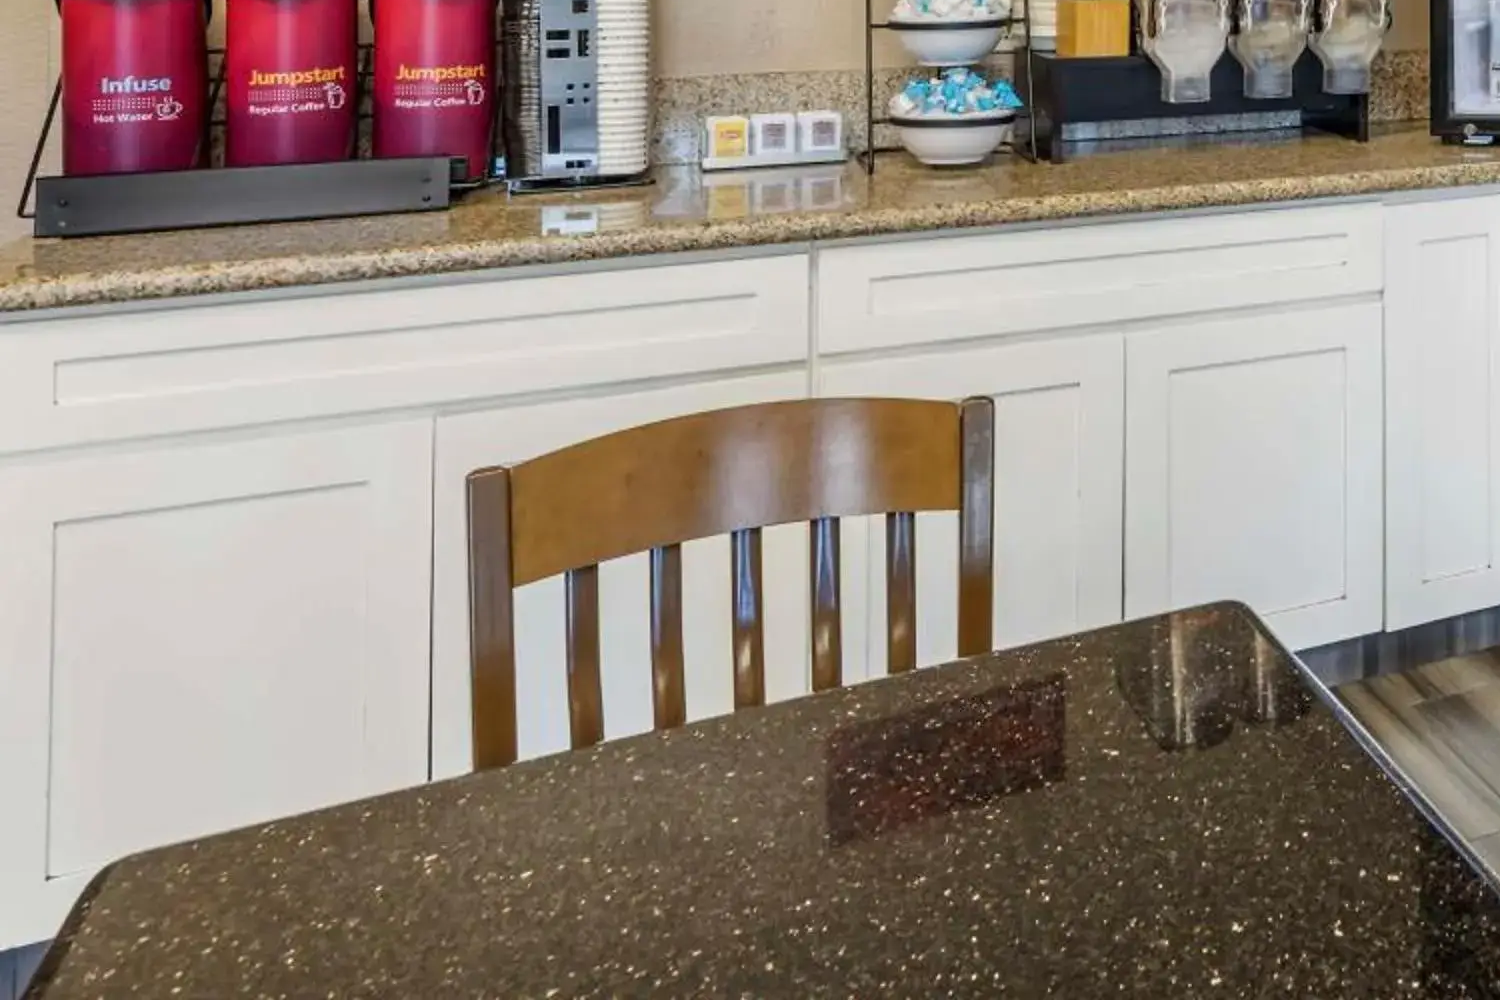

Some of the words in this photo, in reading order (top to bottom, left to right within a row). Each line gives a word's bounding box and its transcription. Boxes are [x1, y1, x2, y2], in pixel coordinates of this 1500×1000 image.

[248, 65, 345, 87] Jumpstart
[396, 63, 486, 84] Jumpstart
[101, 75, 172, 94] Infuse
[290, 101, 325, 112] Coffee
